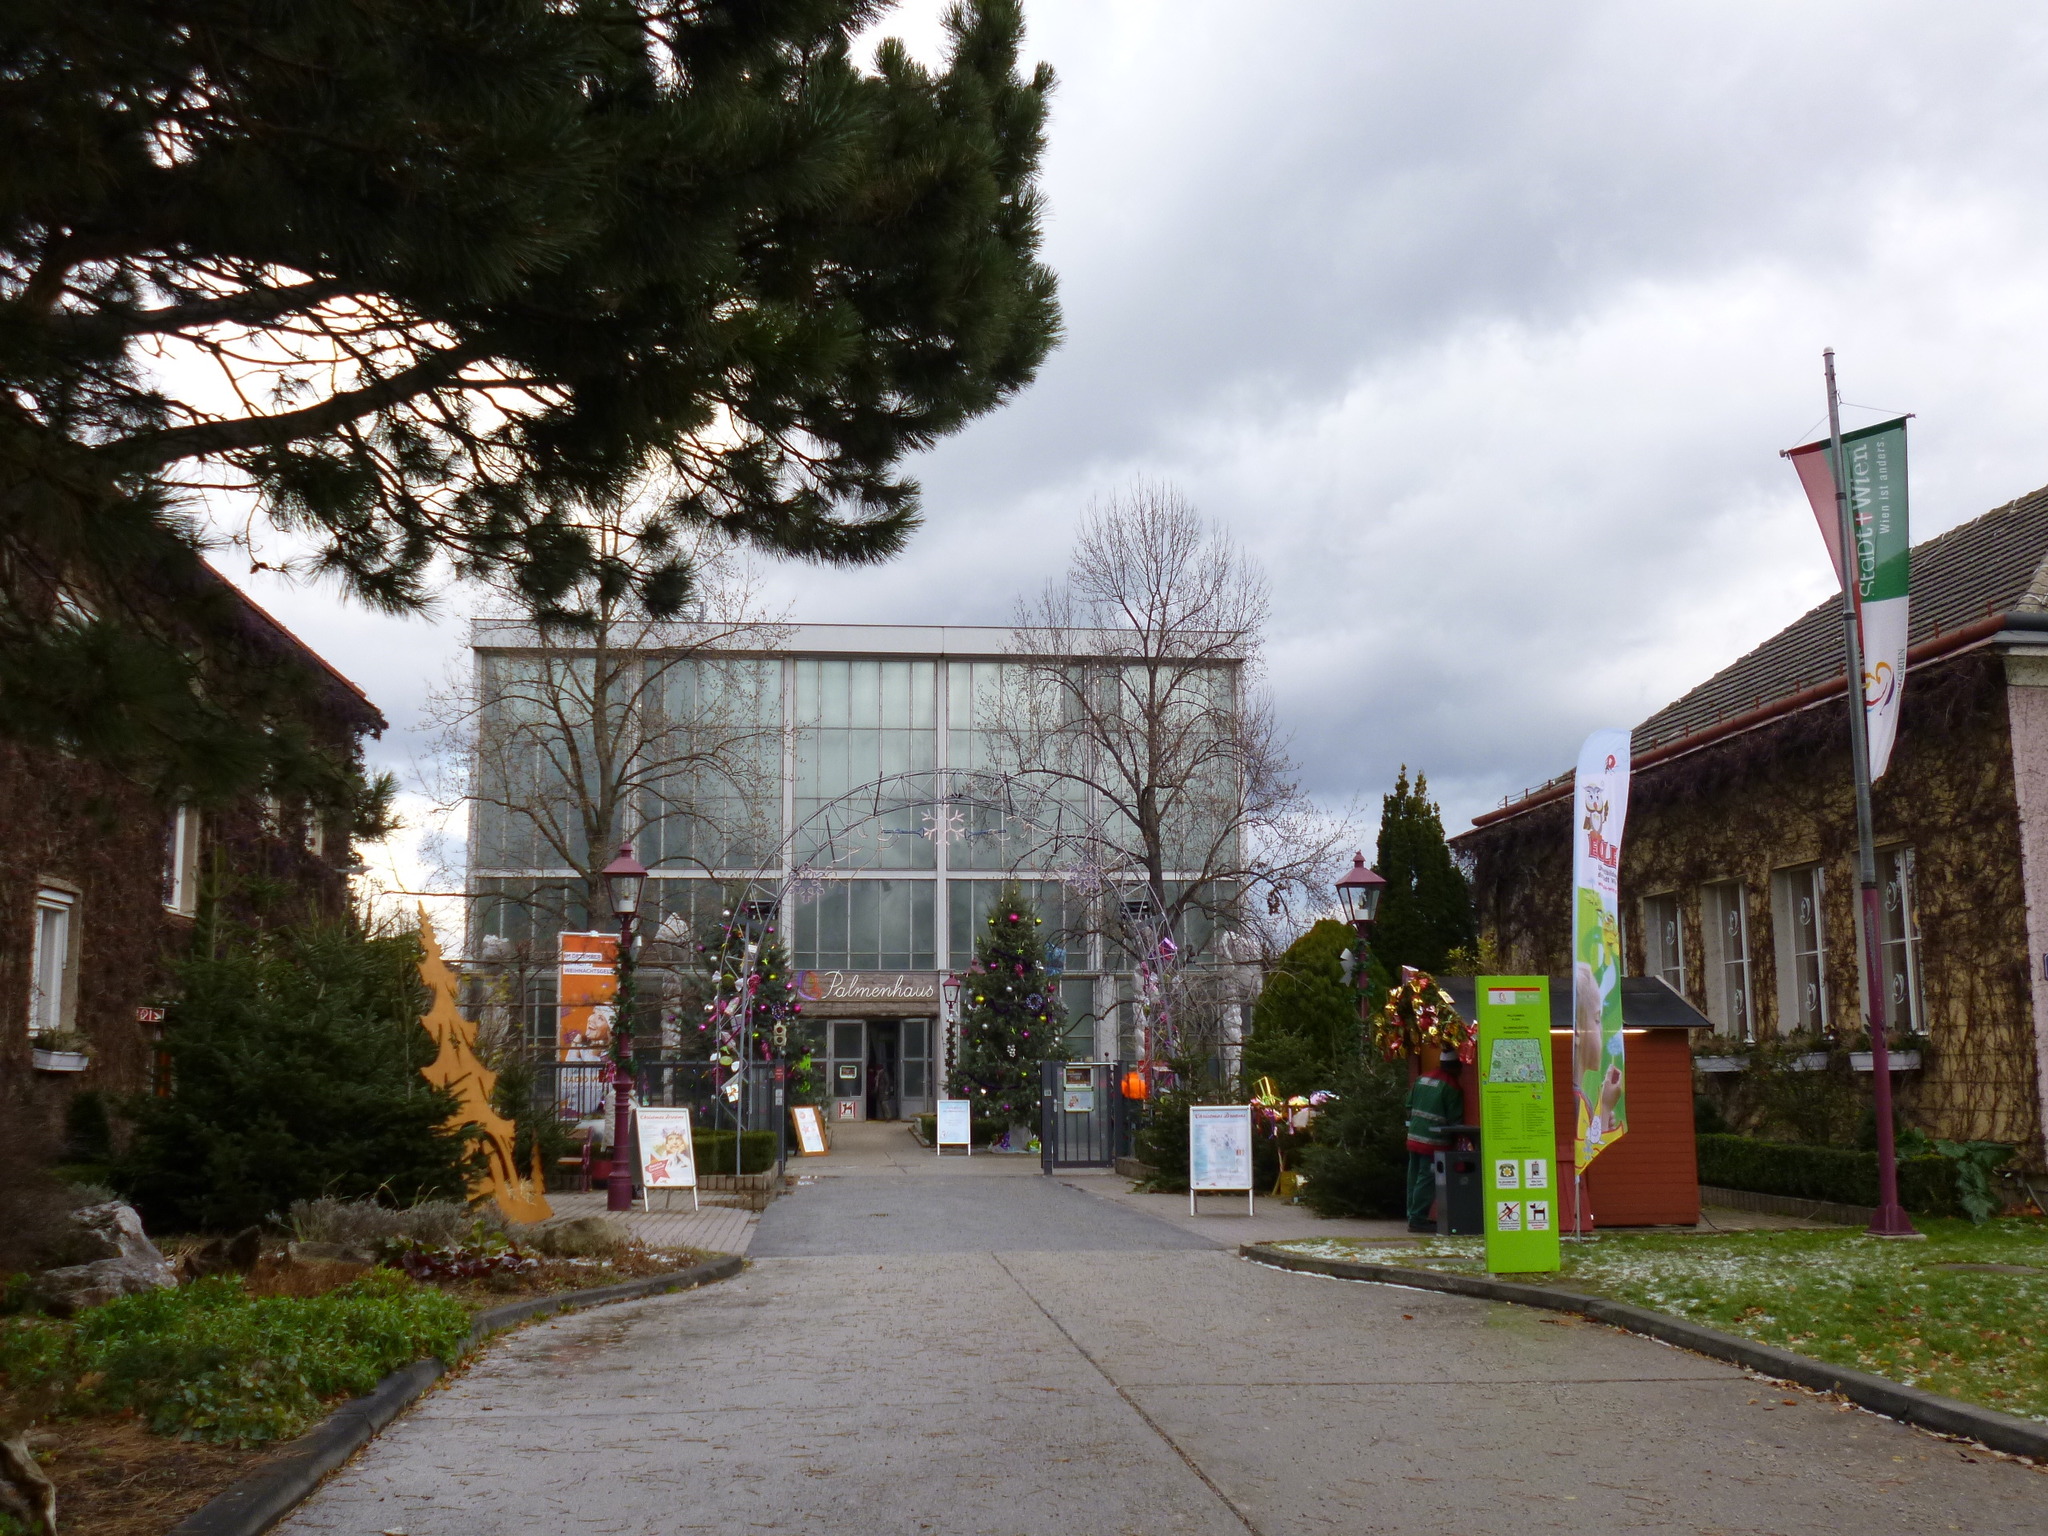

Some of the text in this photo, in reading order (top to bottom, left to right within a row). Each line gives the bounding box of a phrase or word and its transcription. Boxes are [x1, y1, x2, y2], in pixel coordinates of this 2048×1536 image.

[1876, 437, 1890, 534] Wien ist anders.
[821, 969, 934, 999] Palmenhaus
